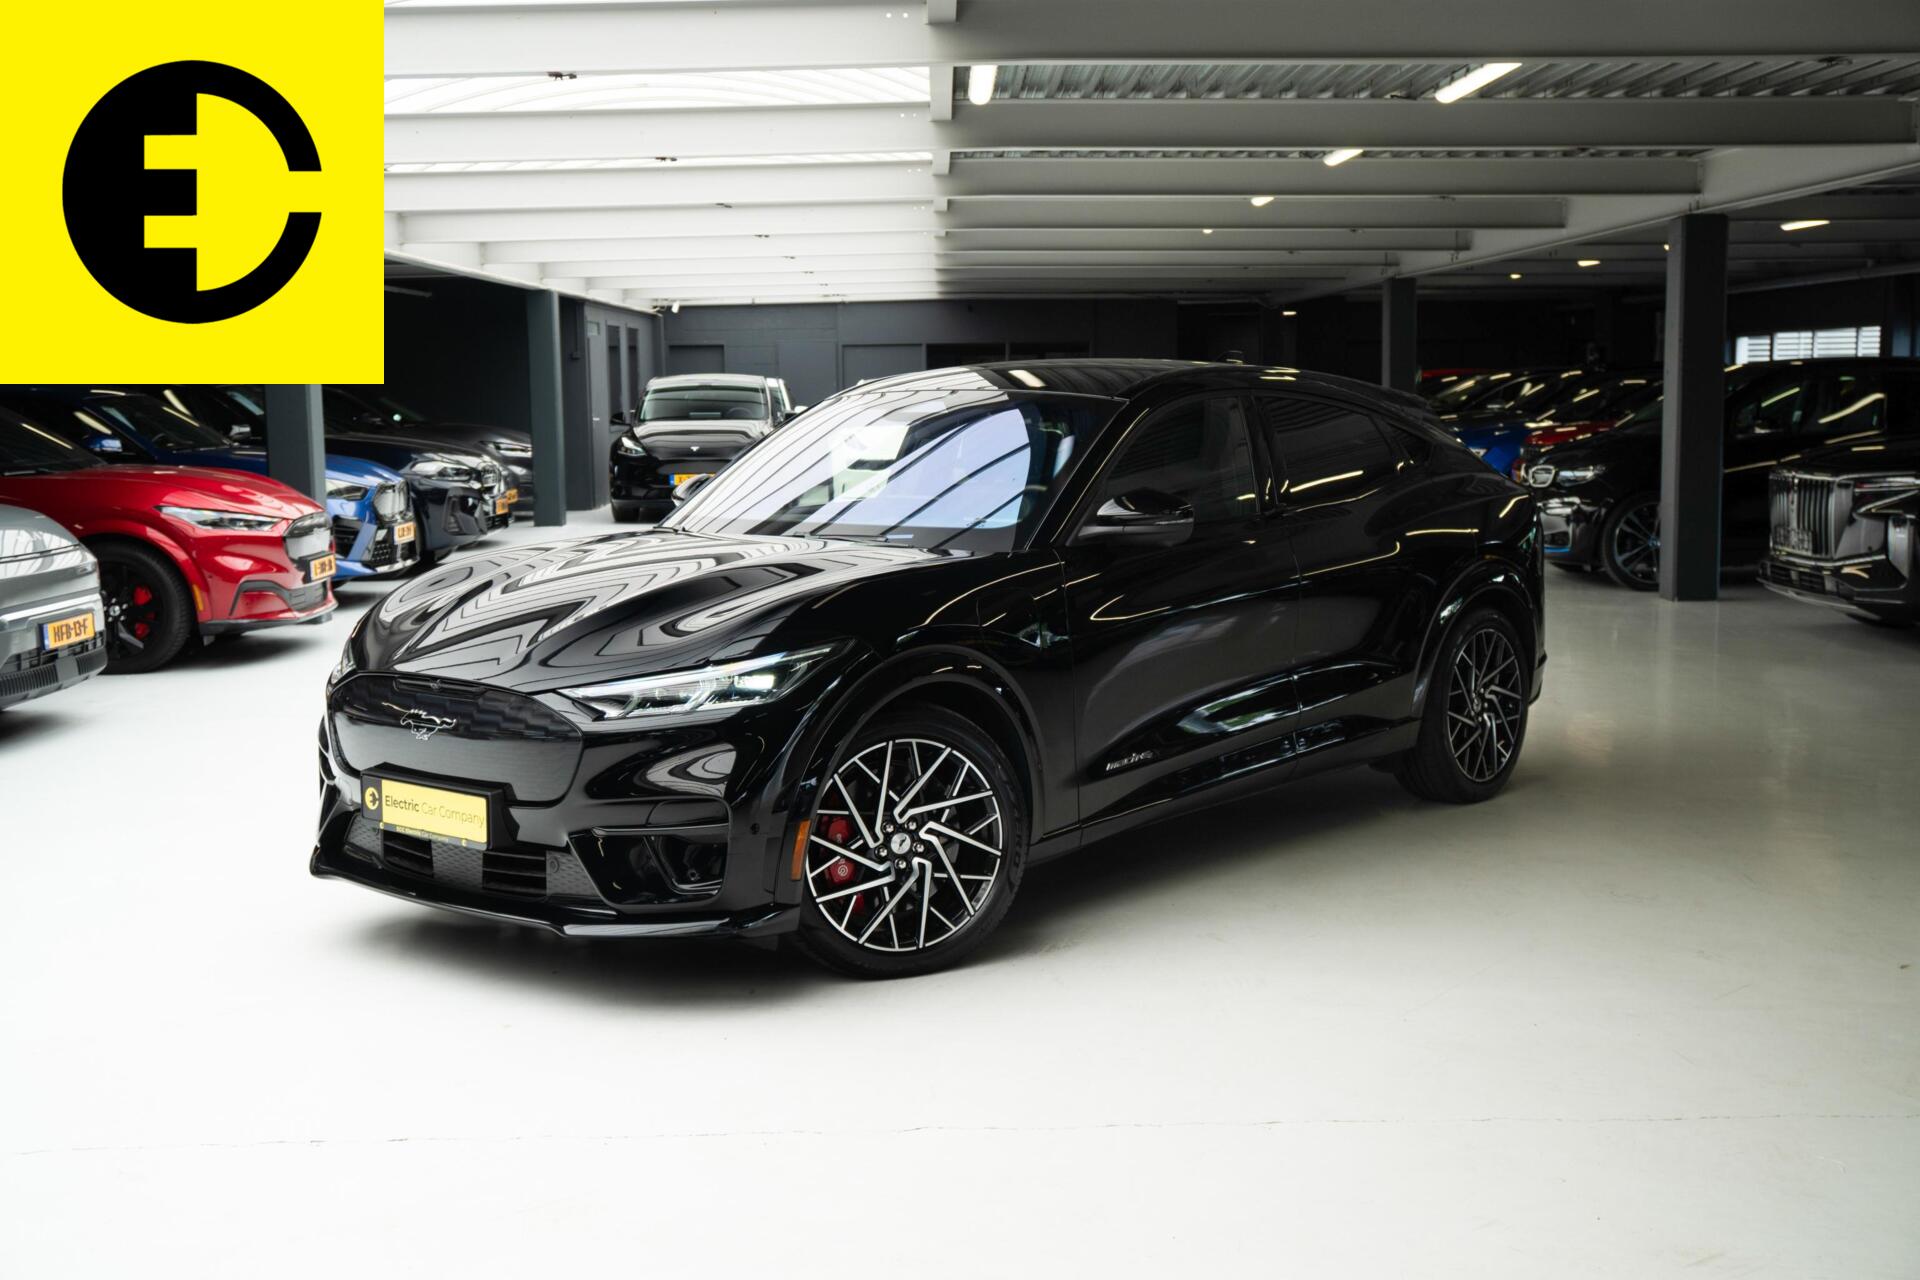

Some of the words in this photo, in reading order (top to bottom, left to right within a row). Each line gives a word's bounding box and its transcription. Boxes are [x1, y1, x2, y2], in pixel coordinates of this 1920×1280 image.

[385, 795, 420, 813] Electric
[421, 802, 437, 815] Car
[439, 806, 485, 828] Company
